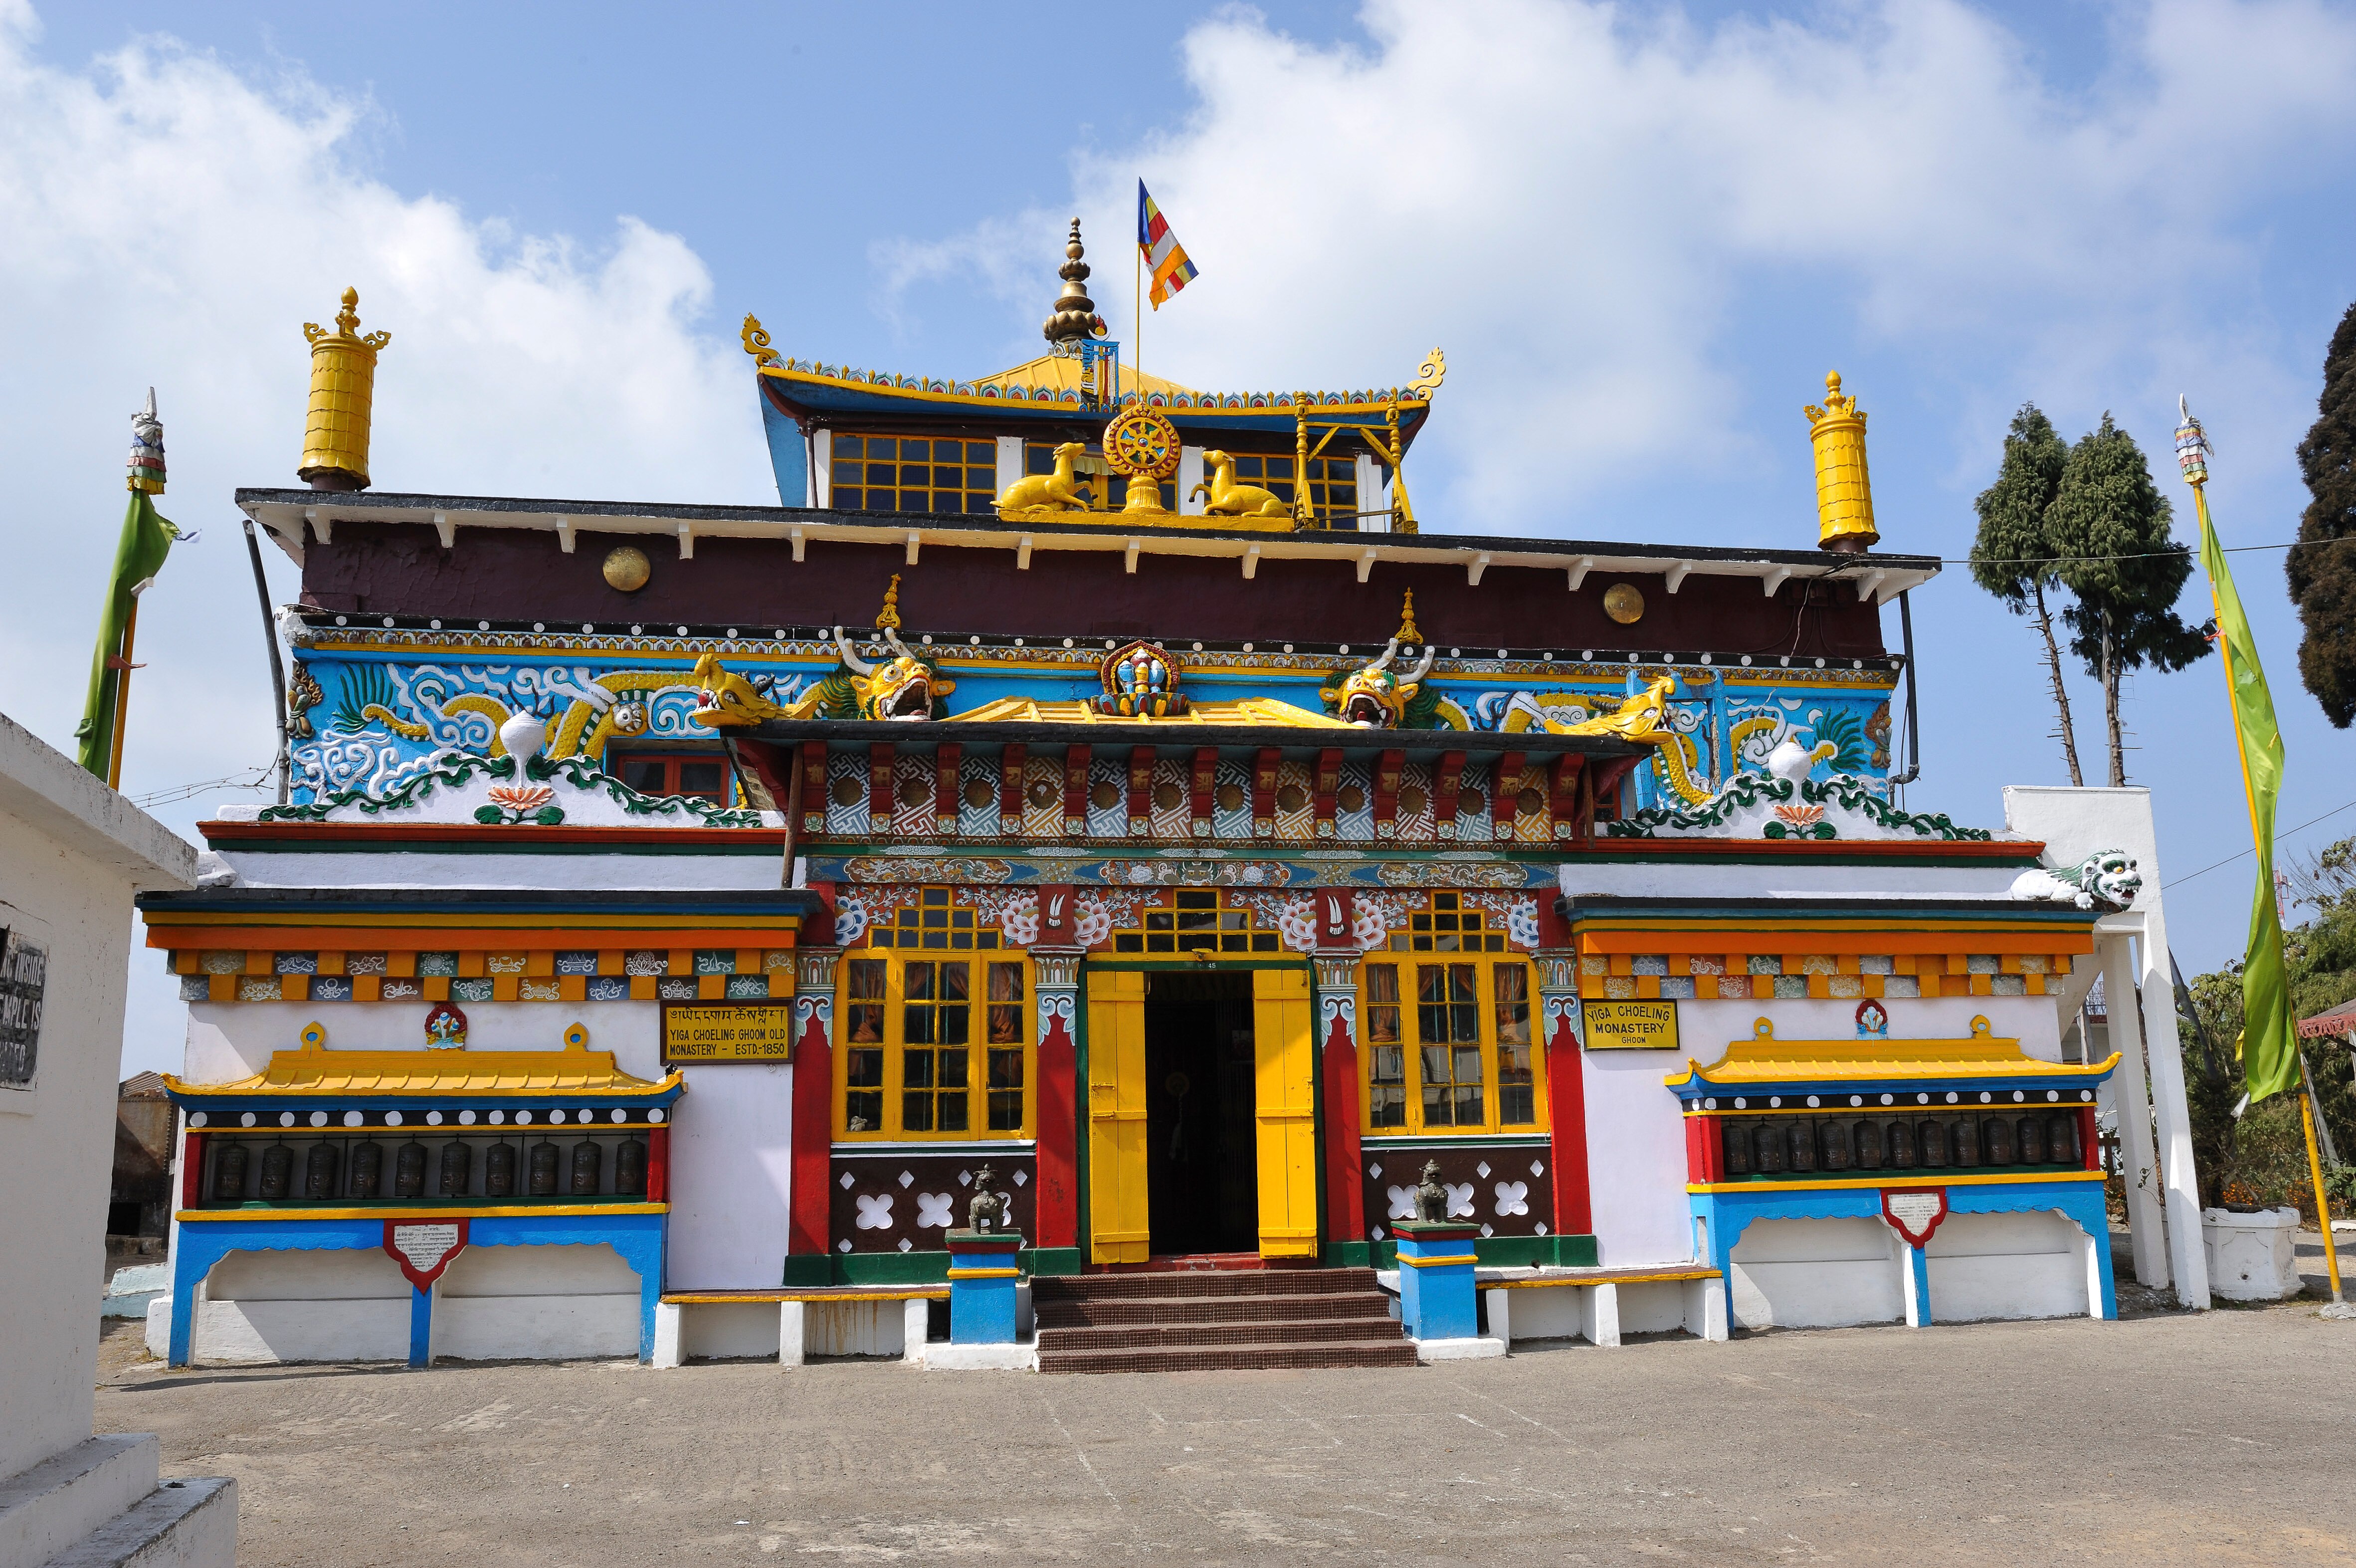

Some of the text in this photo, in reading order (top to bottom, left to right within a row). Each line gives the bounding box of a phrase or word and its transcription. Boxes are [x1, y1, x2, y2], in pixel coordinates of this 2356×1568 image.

[15, 953, 44, 986] INSIDE
[31, 1000, 40, 1030] IS
[1586, 1005, 1670, 1022] YIGA CHOELING
[670, 1028, 785, 1040] YIGA CHOELING GHOOM OLD
[1595, 1023, 1665, 1033] MONASTERY
[670, 1044, 717, 1055] MONASTERY
